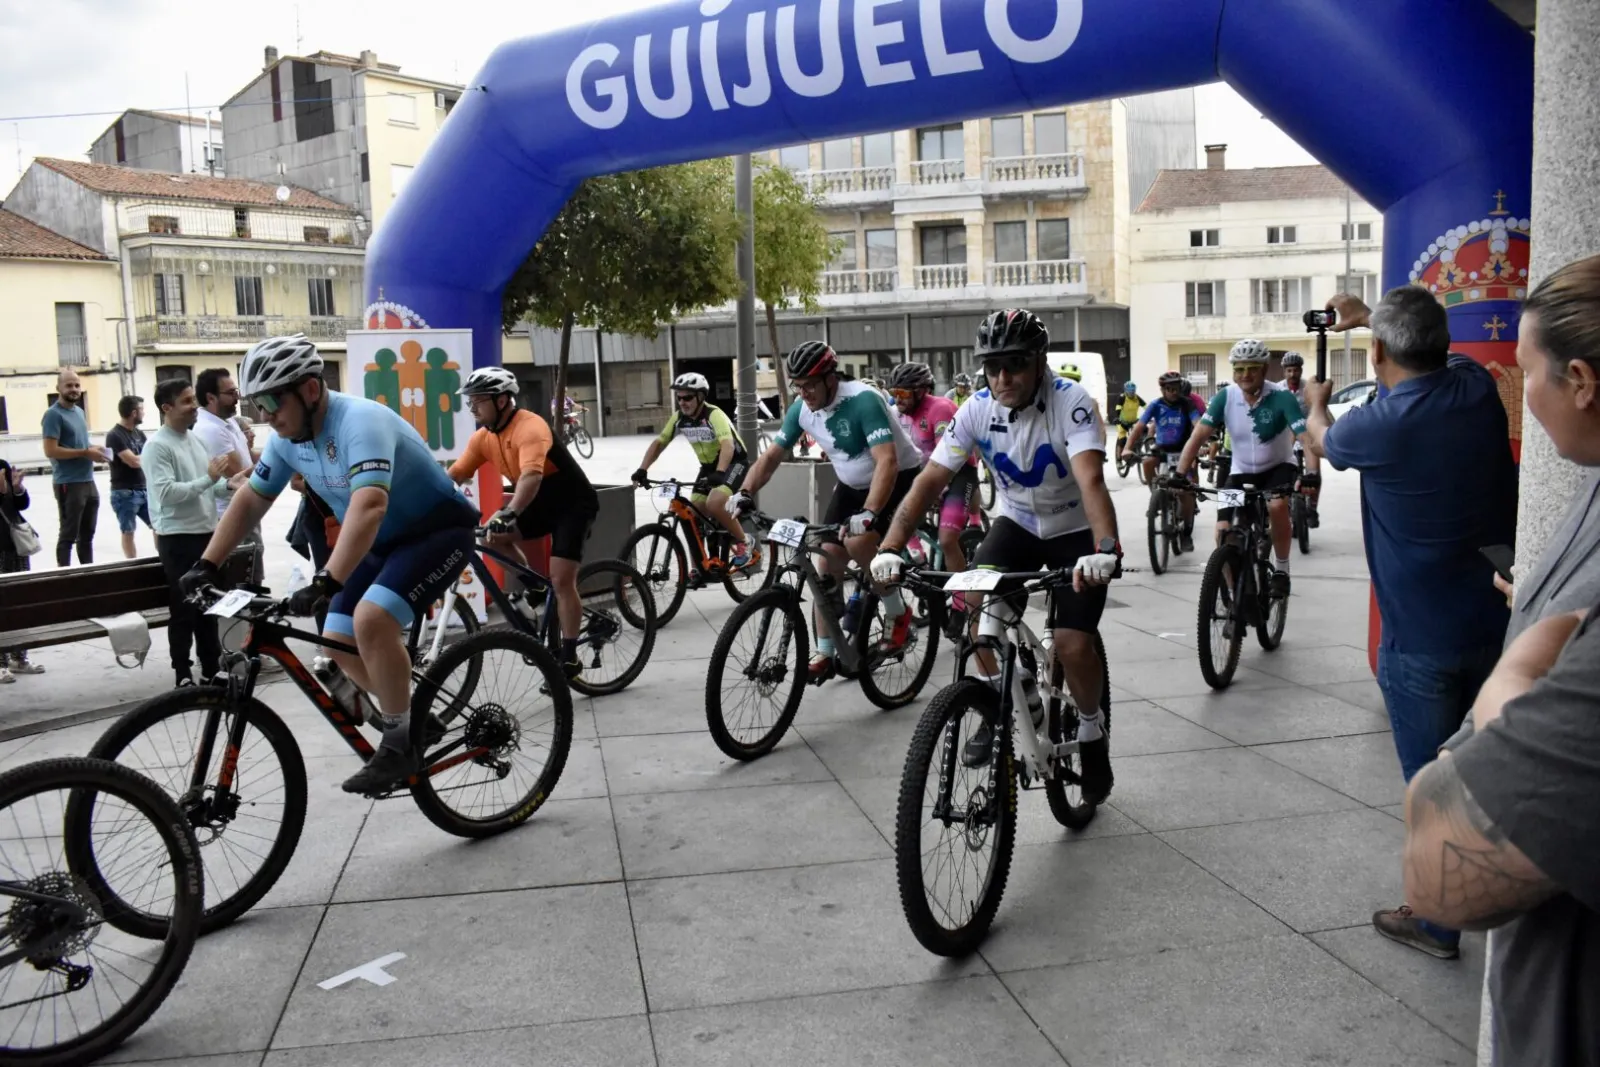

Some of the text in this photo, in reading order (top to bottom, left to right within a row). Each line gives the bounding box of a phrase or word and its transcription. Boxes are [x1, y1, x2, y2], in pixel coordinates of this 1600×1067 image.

[779, 525, 796, 538] 39
[408, 583, 426, 602] BTT
[425, 548, 464, 585] VILLARES
[939, 720, 956, 794] MANITOU
[988, 724, 1003, 799] MANITOU
[171, 823, 199, 895] GOODYEAR
